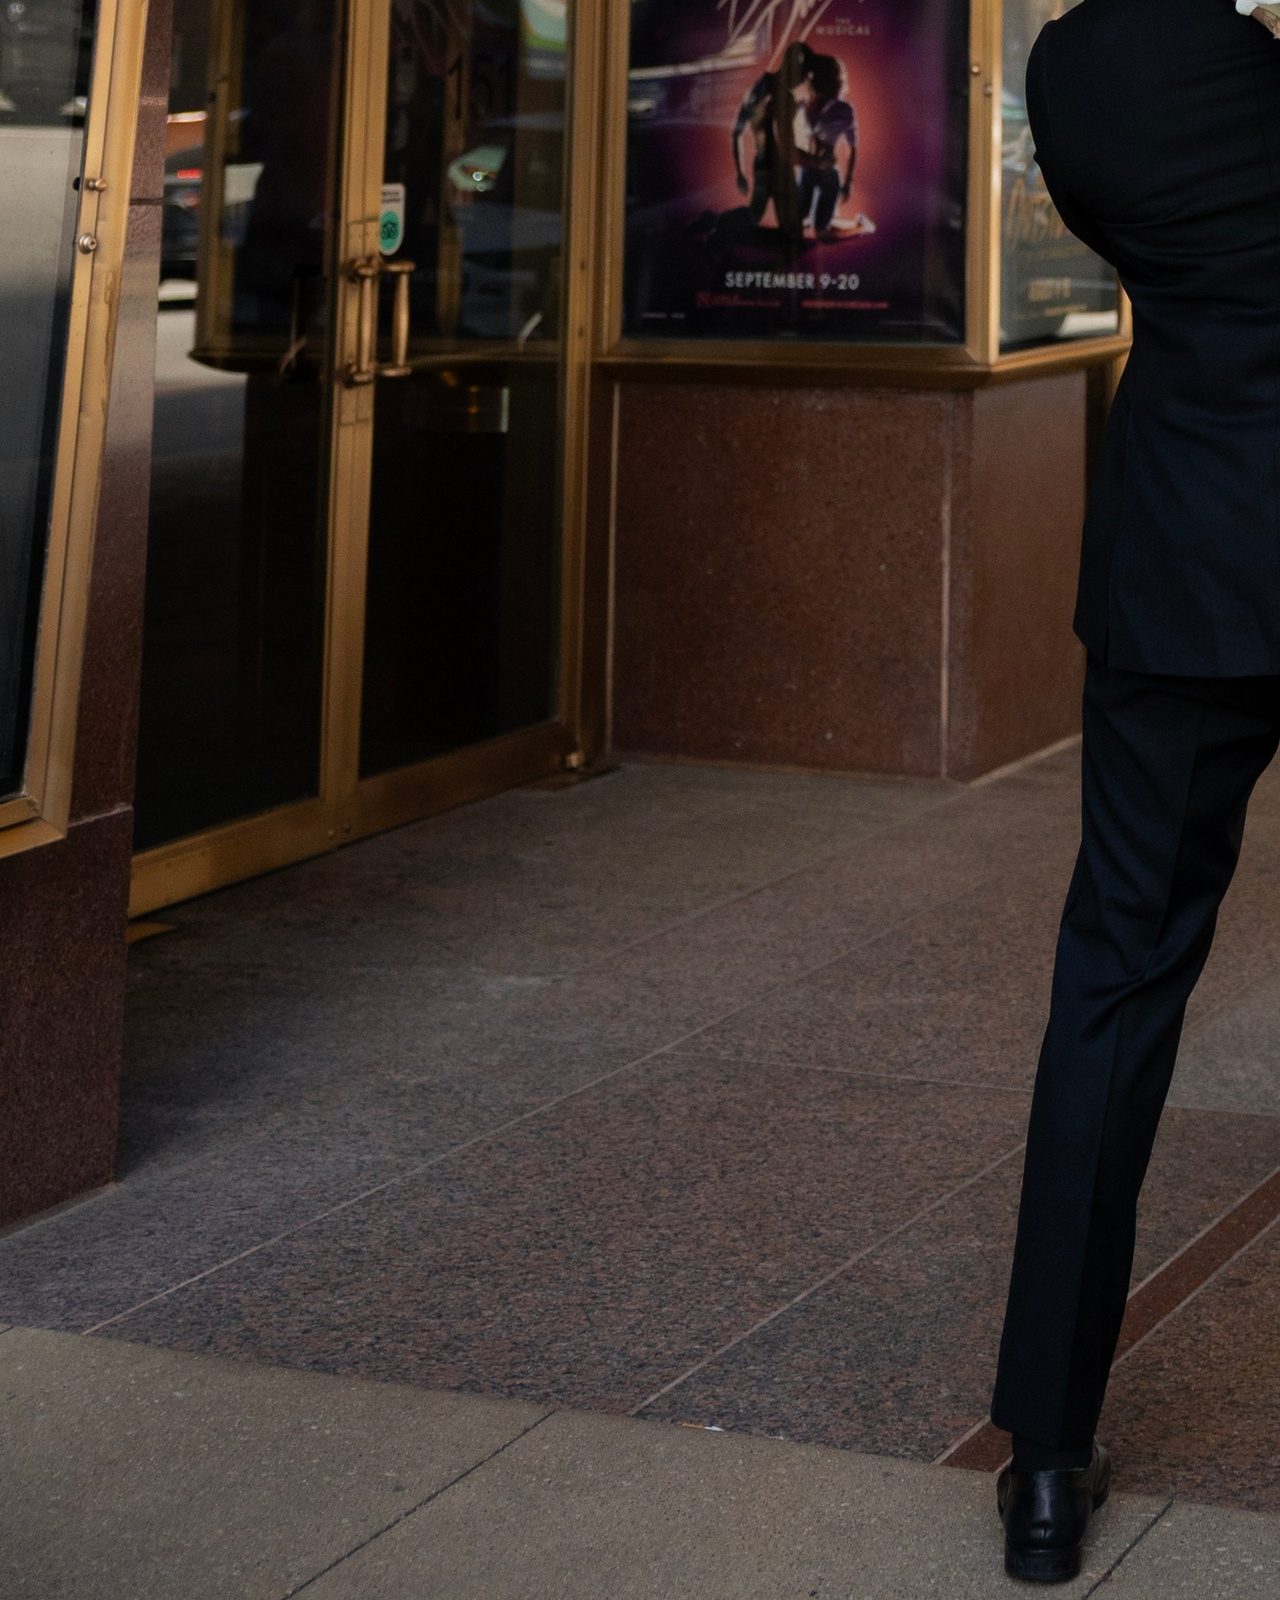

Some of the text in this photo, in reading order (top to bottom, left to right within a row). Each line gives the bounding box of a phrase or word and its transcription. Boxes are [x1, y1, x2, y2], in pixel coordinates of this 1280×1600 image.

[814, 24, 871, 37] MUSICAL
[724, 271, 861, 291] SEPTEMBER 9-20
